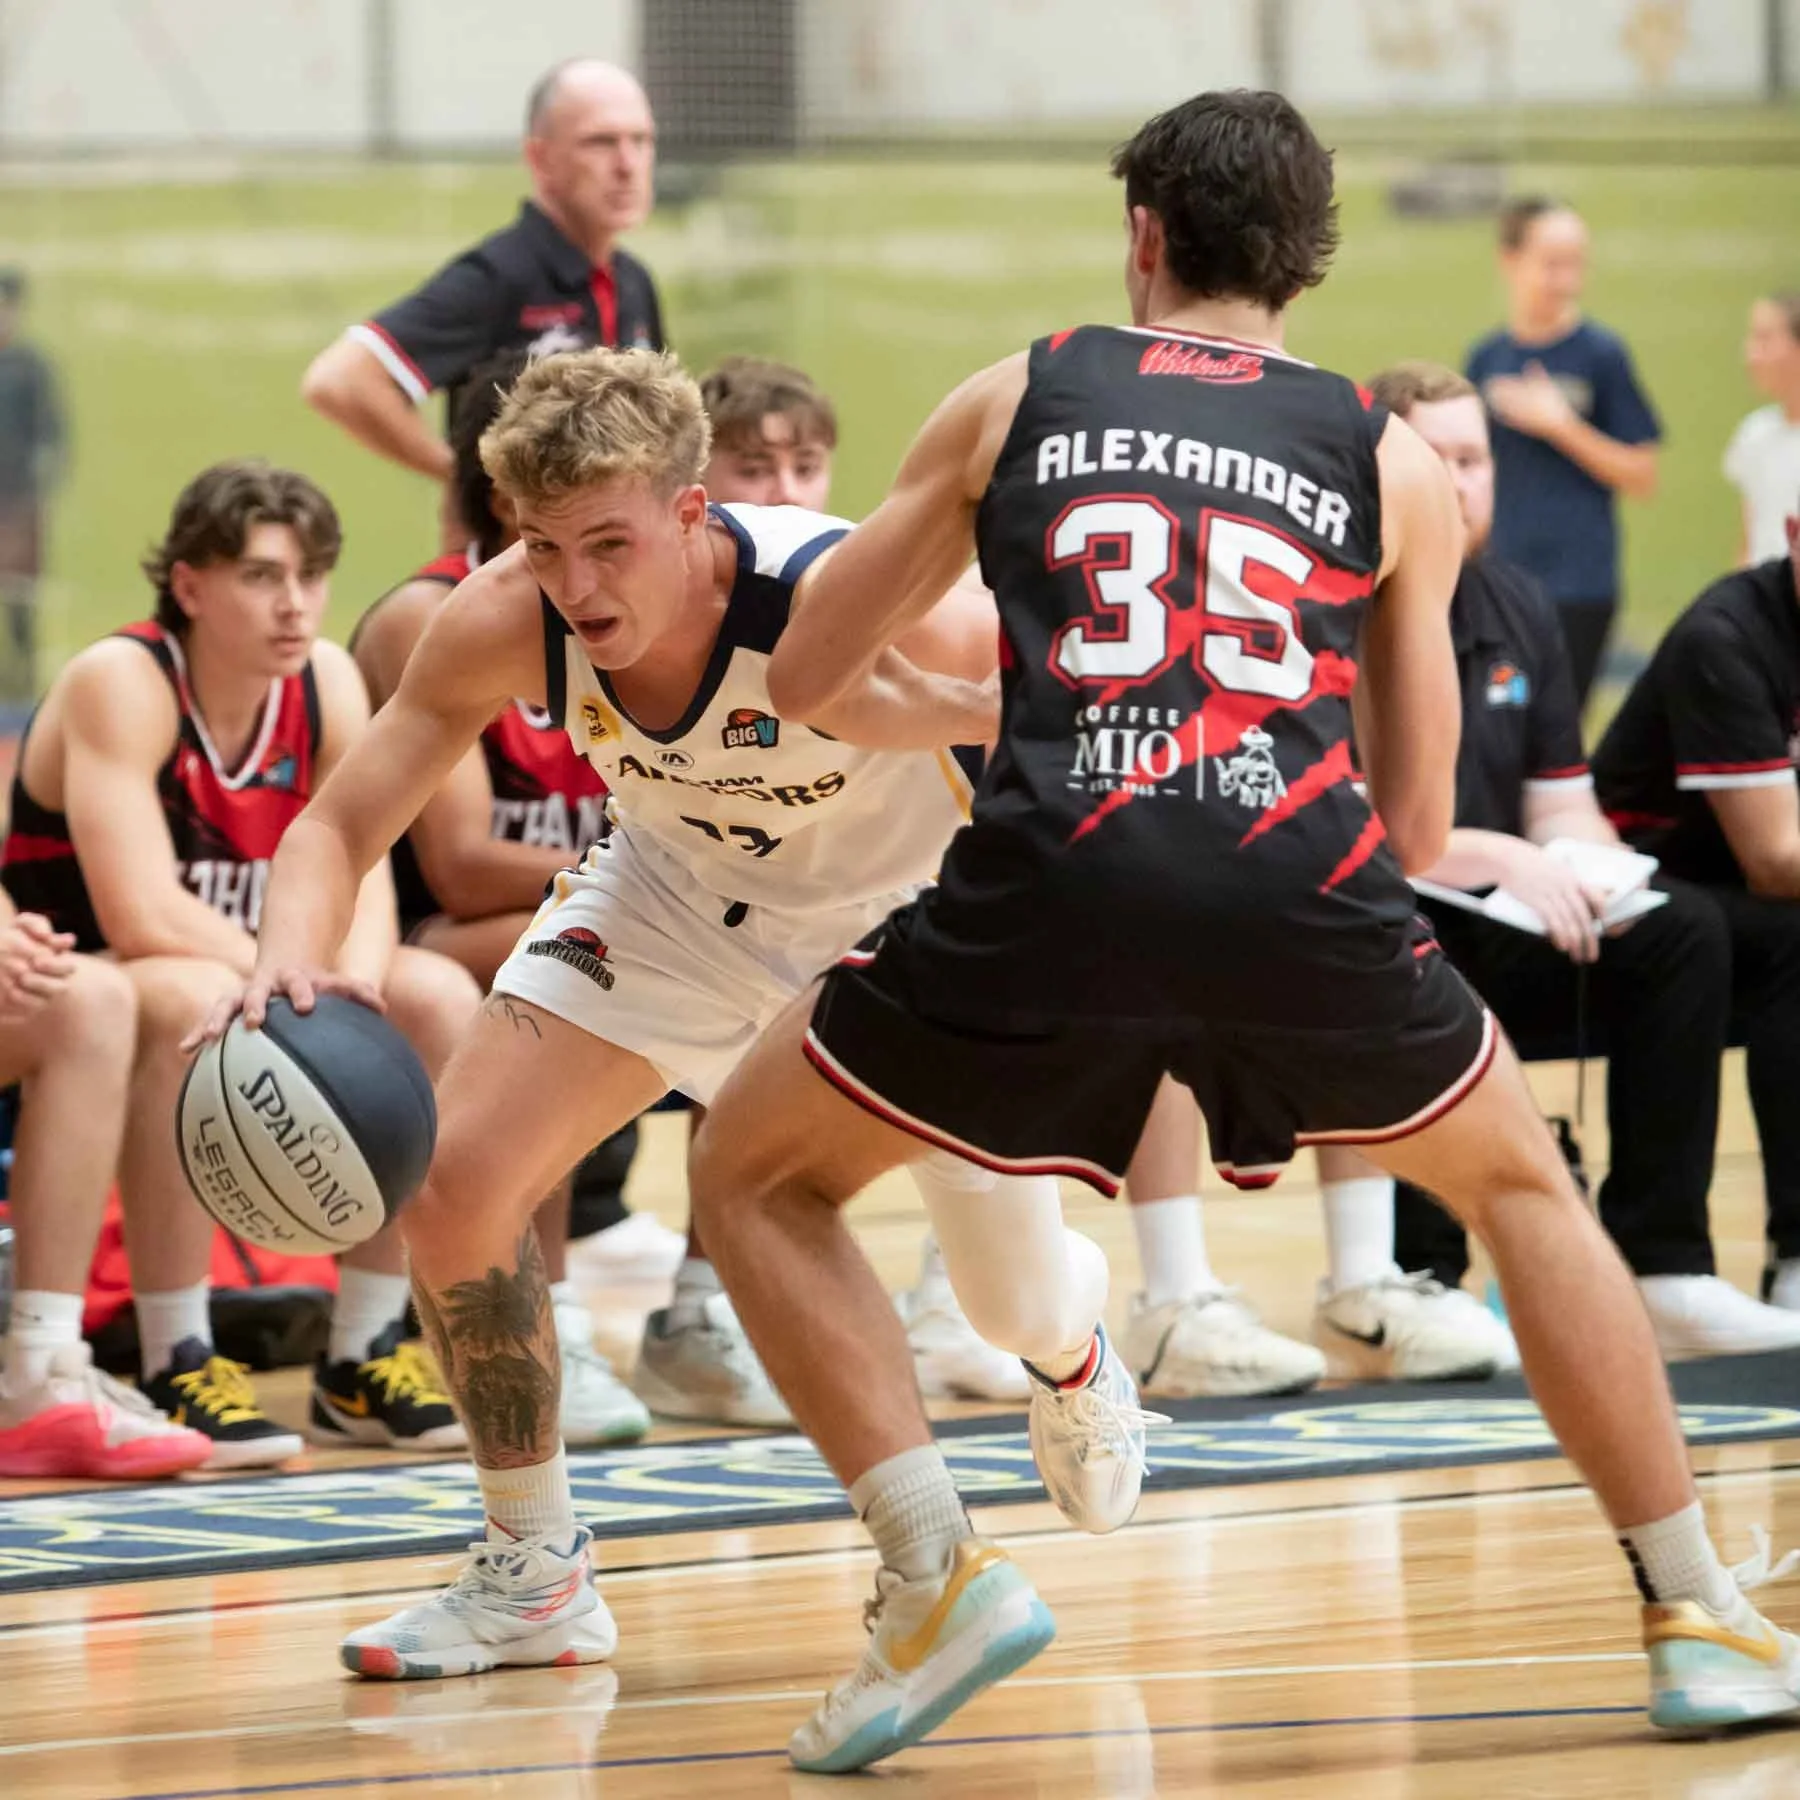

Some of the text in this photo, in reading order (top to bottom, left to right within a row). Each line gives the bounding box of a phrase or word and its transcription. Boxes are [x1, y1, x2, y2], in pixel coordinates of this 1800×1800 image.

[1036, 428, 1351, 547] ALEXANDER
[1045, 492, 1319, 709] 35
[1069, 728, 1183, 779] MIO
[199, 1115, 296, 1241] LEGACY
[237, 1067, 363, 1228] SPALDING
